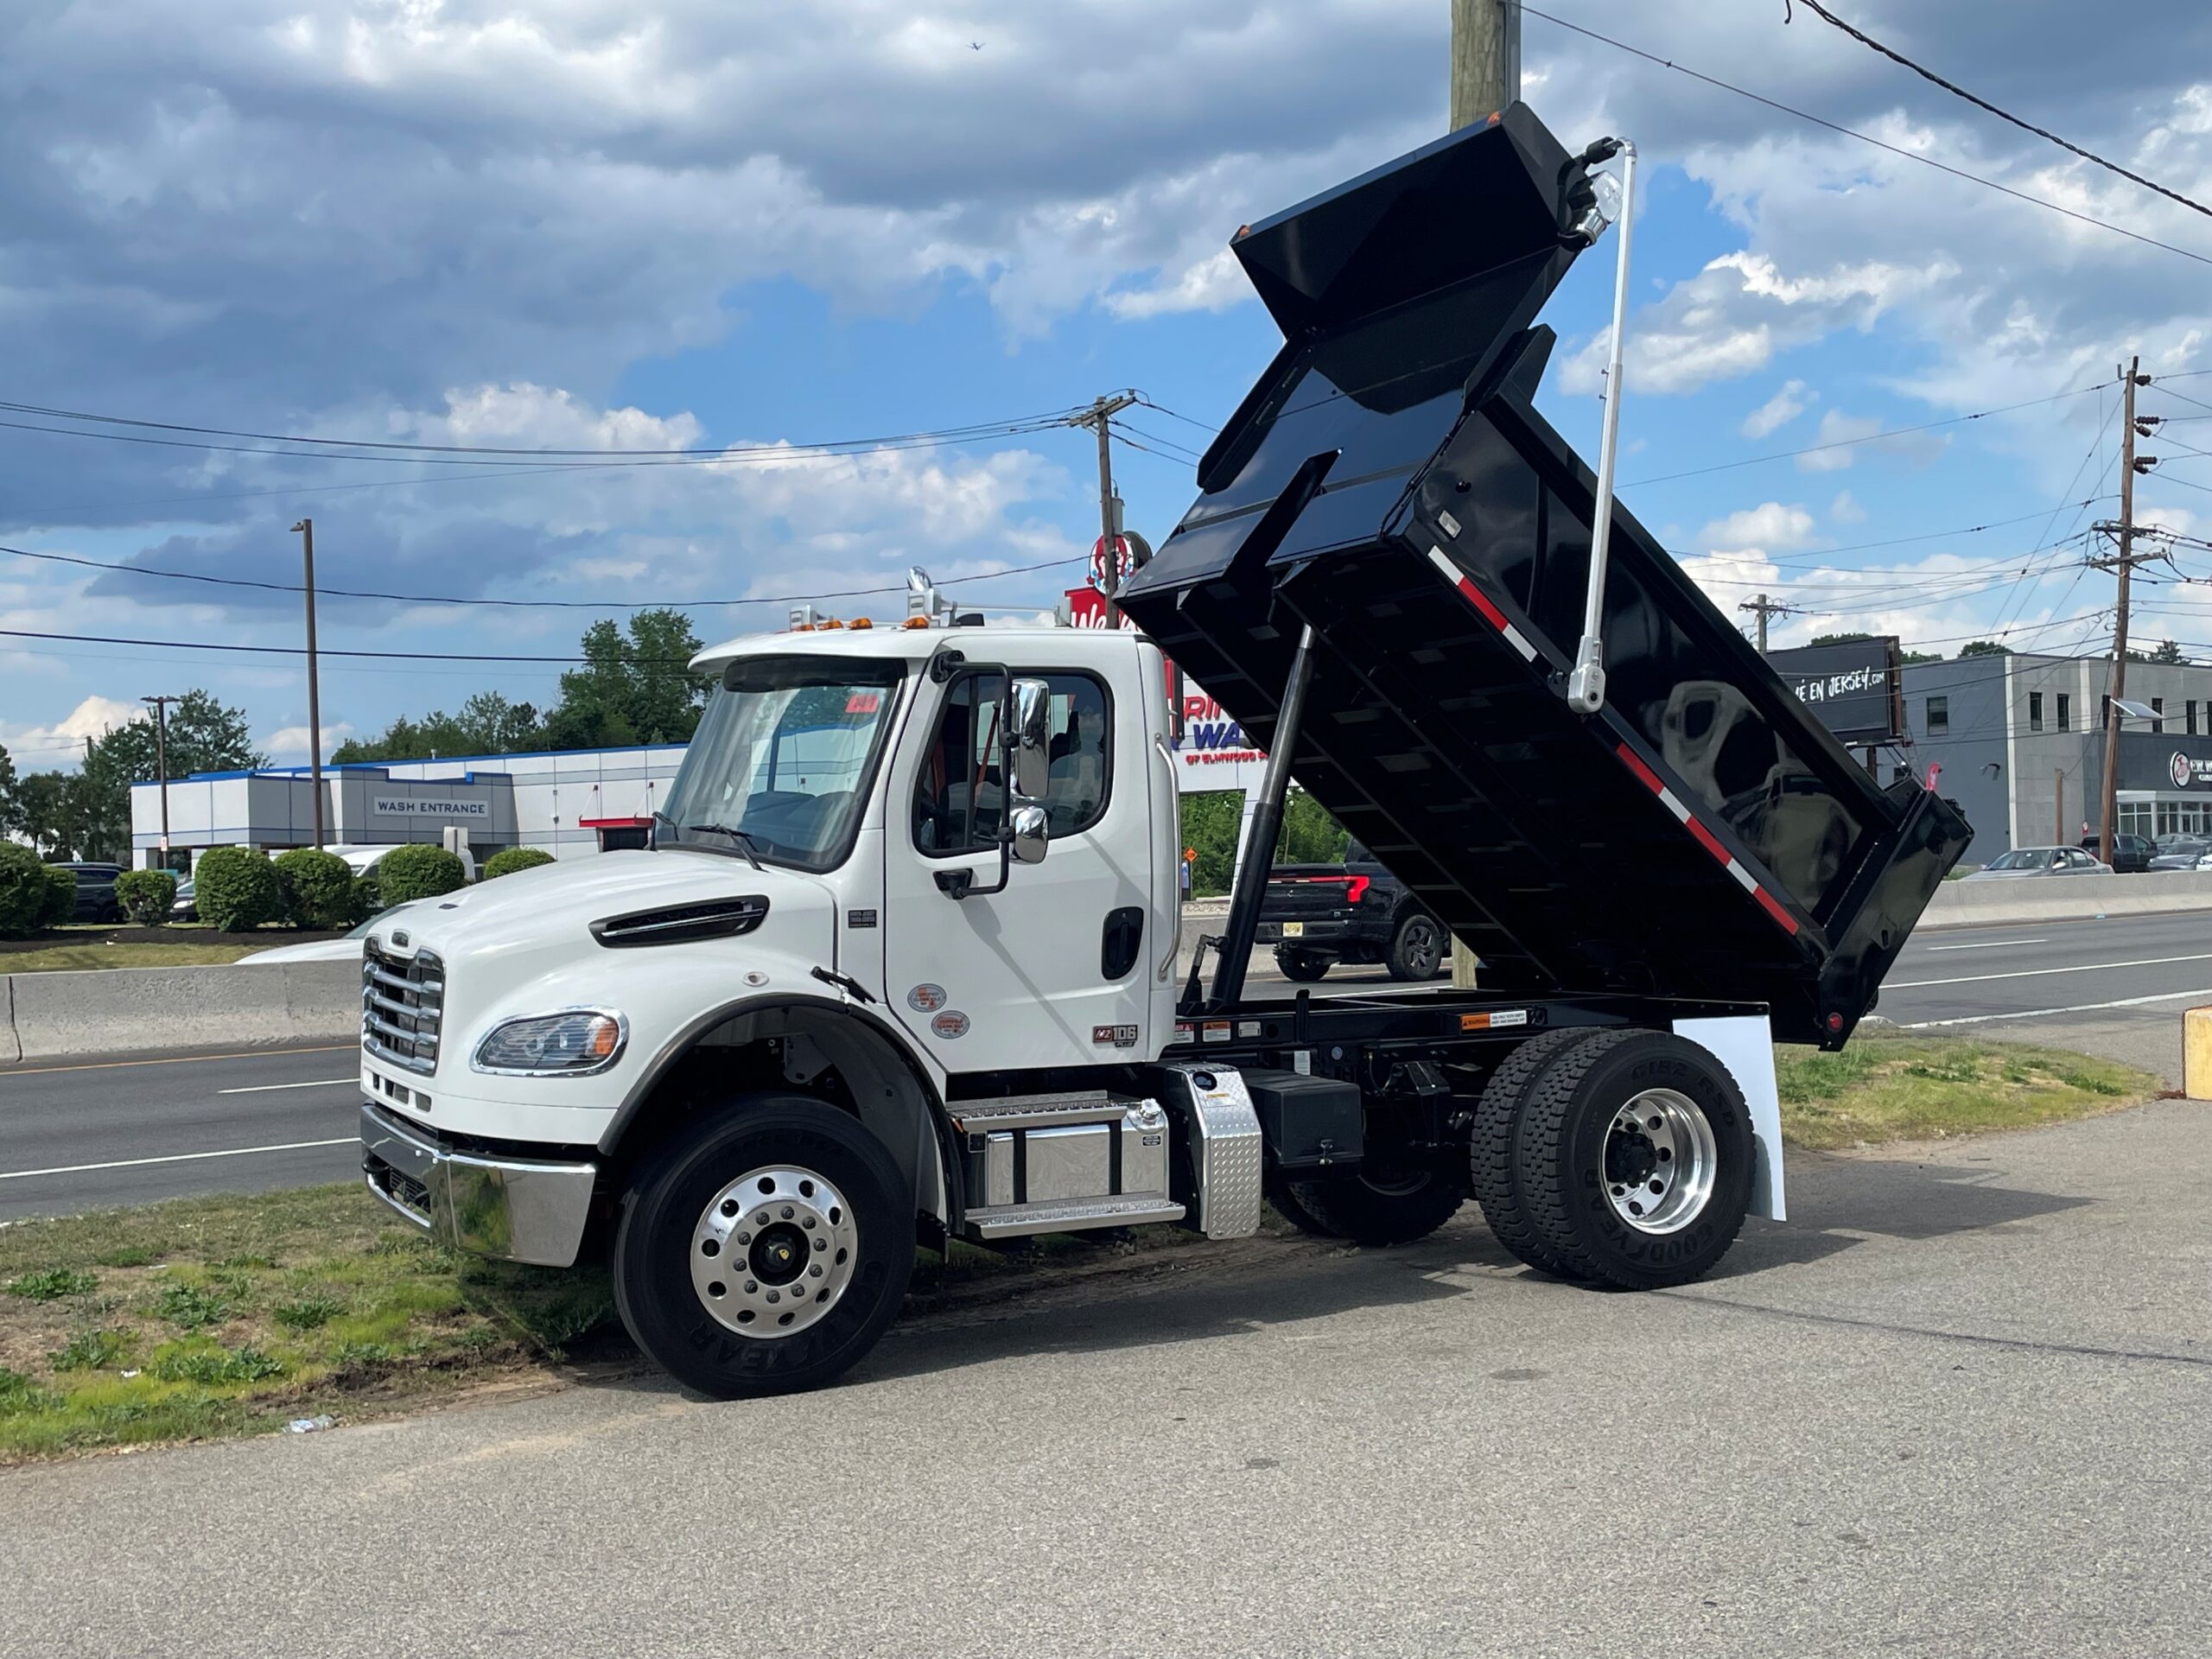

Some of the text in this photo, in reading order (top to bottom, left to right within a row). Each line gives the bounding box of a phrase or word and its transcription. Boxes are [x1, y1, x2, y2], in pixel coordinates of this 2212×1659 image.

[1809, 679, 1824, 702] EN
[1192, 721, 1242, 751] WA
[1202, 751, 1256, 764] ELMWOOD
[378, 801, 486, 813] WASH ENTRANCE
[1113, 1027, 1137, 1040] 106
